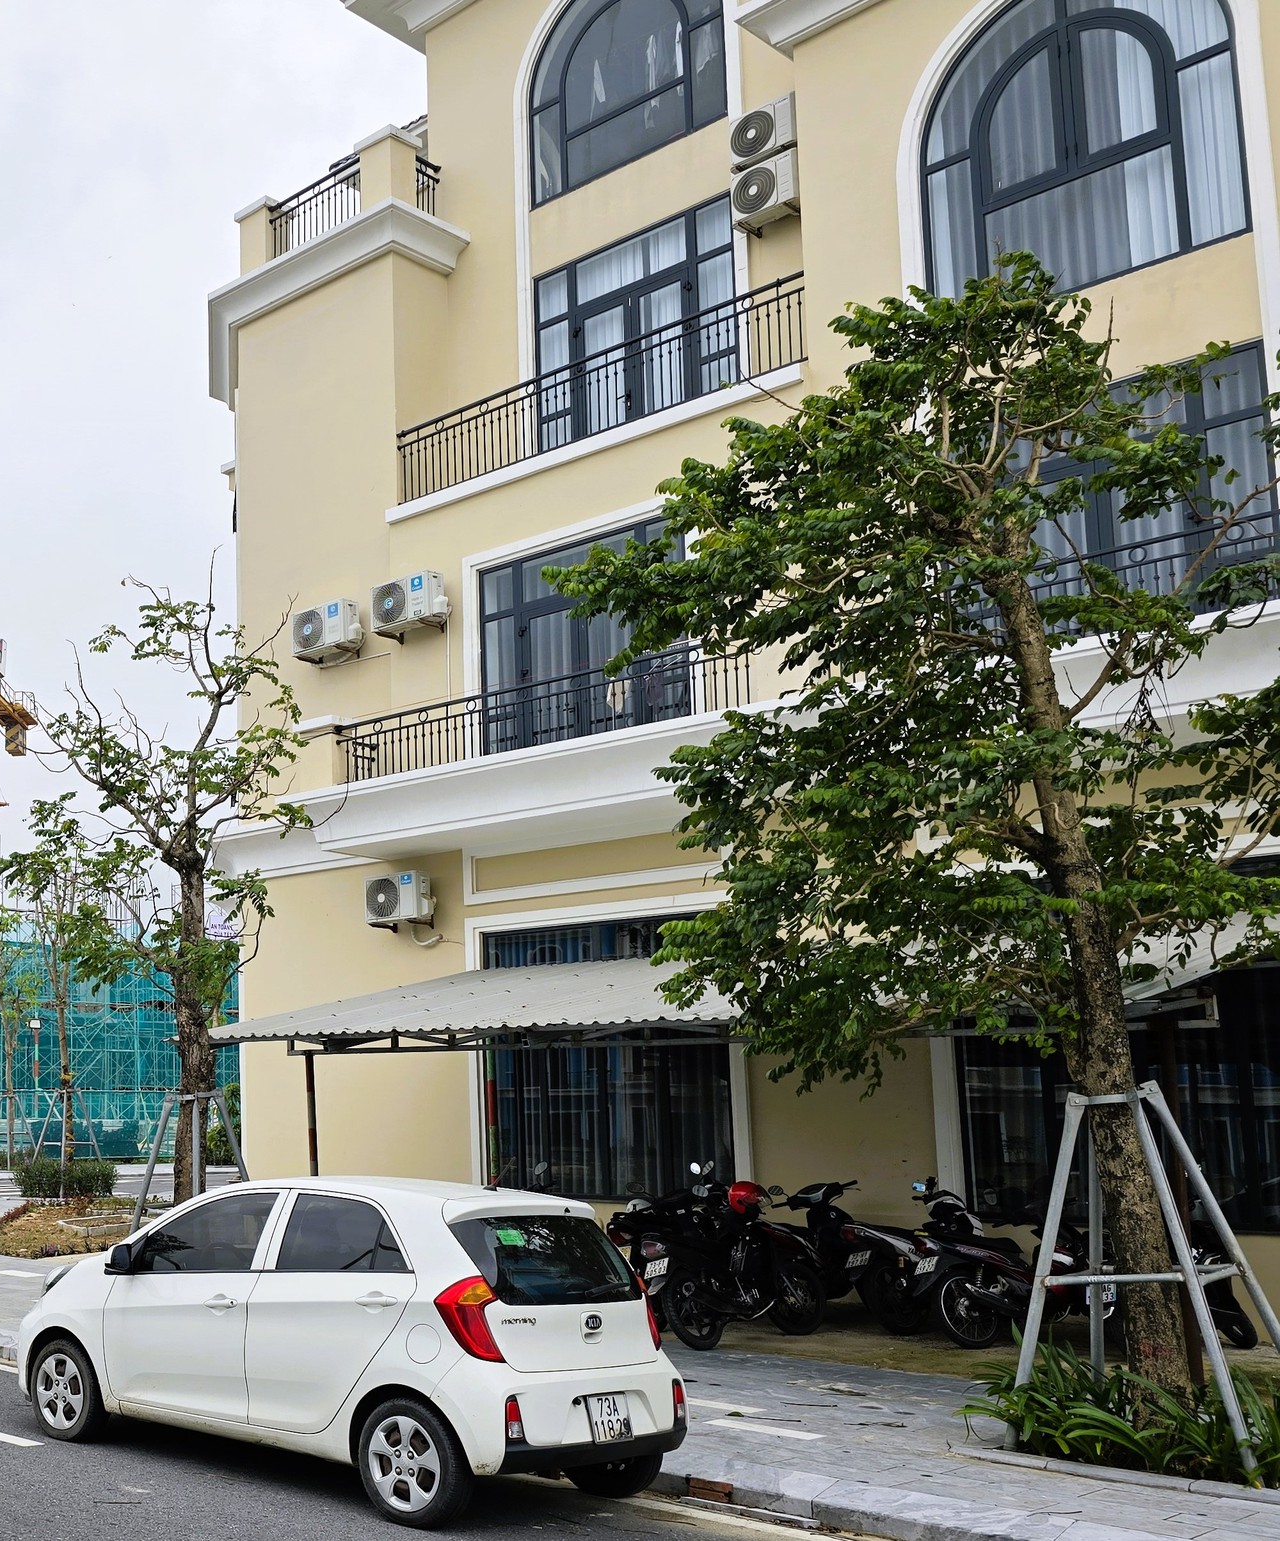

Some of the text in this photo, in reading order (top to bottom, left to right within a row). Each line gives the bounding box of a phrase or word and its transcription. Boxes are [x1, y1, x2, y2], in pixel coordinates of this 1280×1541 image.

[501, 1317, 537, 1326] morning
[587, 1317, 602, 1329] KIA
[597, 1396, 620, 1418] 73A
